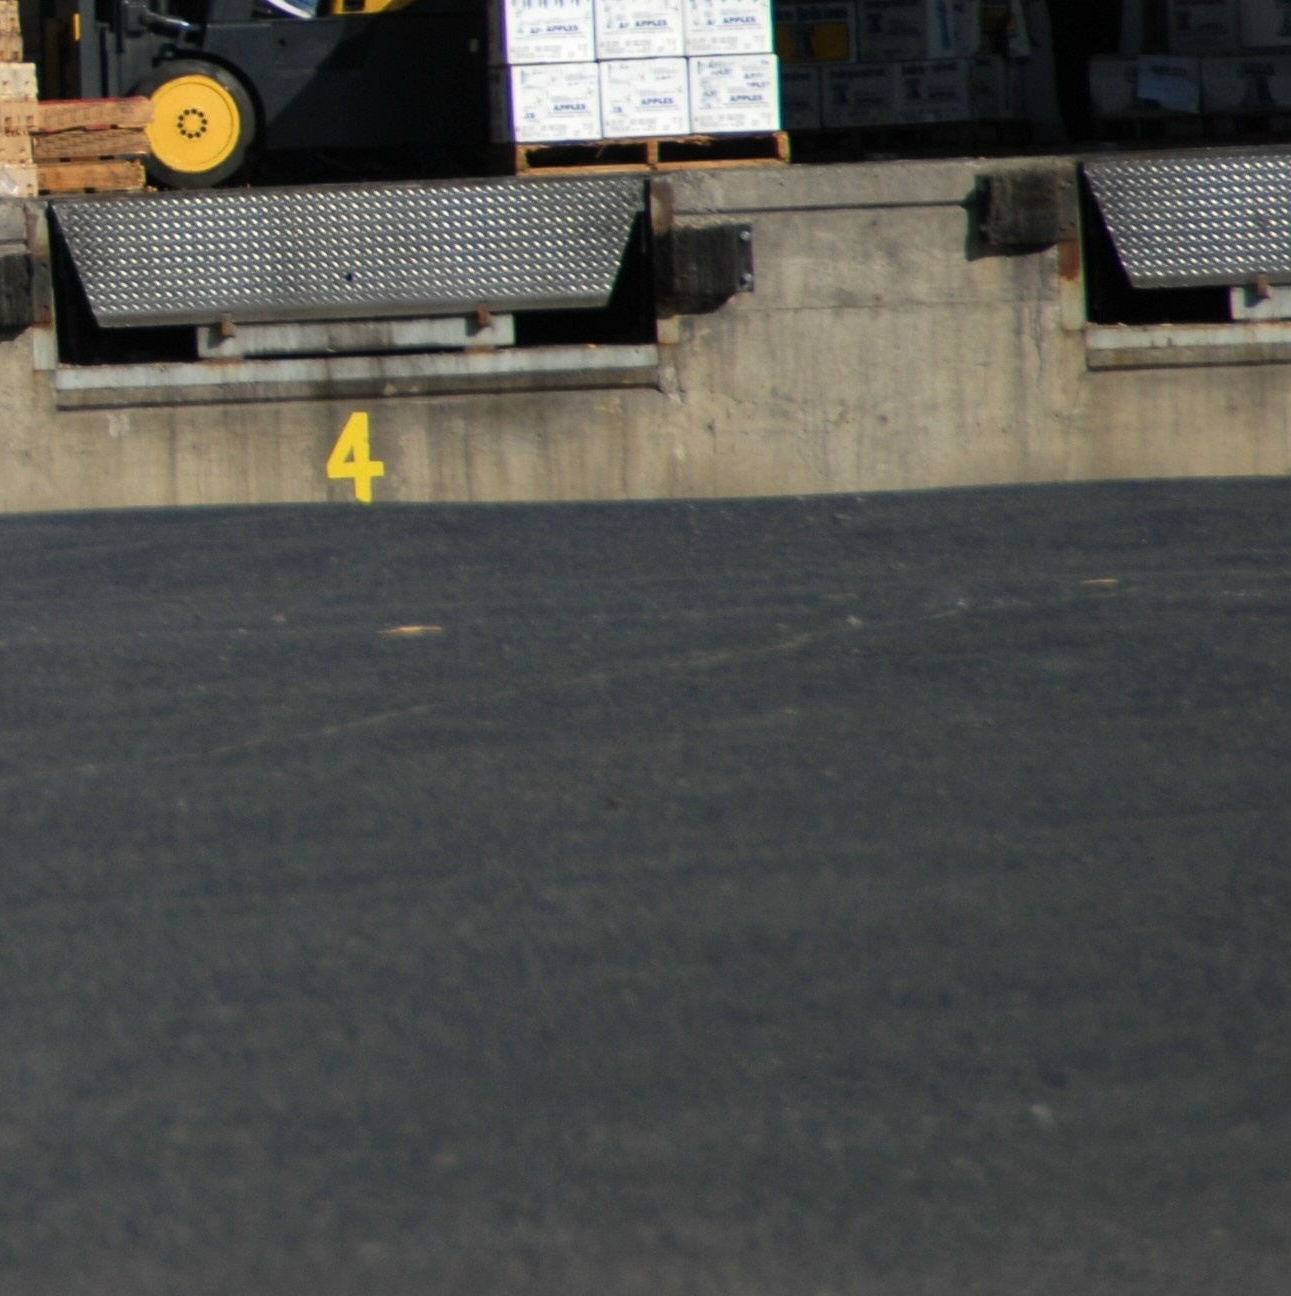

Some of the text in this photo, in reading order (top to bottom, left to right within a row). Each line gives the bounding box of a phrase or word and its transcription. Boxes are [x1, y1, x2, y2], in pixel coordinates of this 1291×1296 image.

[634, 18, 668, 28] APPLES
[722, 15, 756, 25] APPLES
[640, 96, 675, 106] APPLES
[729, 93, 764, 103] APPLES
[552, 102, 587, 113] APPLES
[327, 411, 385, 504] 4
